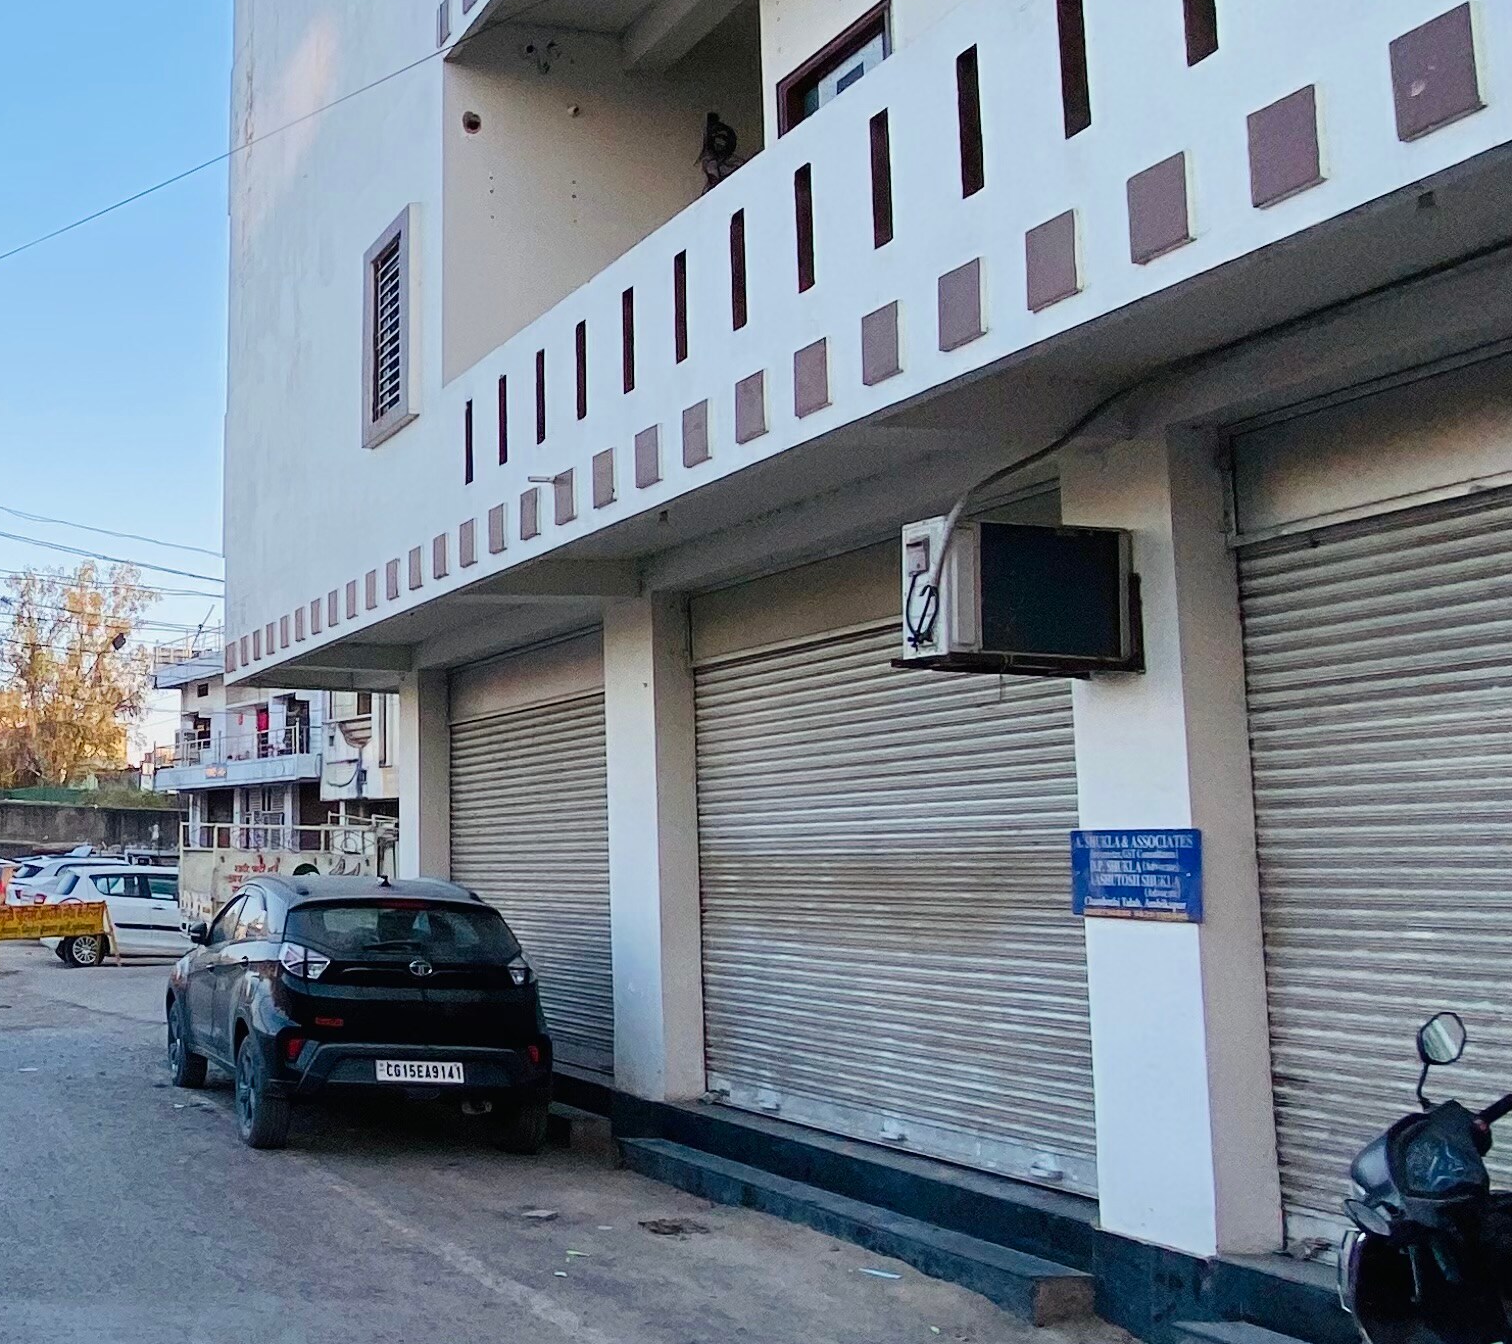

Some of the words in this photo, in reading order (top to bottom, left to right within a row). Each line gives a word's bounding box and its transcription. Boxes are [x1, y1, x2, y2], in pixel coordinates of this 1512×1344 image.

[1085, 835, 1120, 848] SHUKLA
[1131, 835, 1193, 848] ASSOCIATES
[1107, 860, 1141, 873] SHUKLA
[386, 1062, 462, 1079] CG15EA9141
